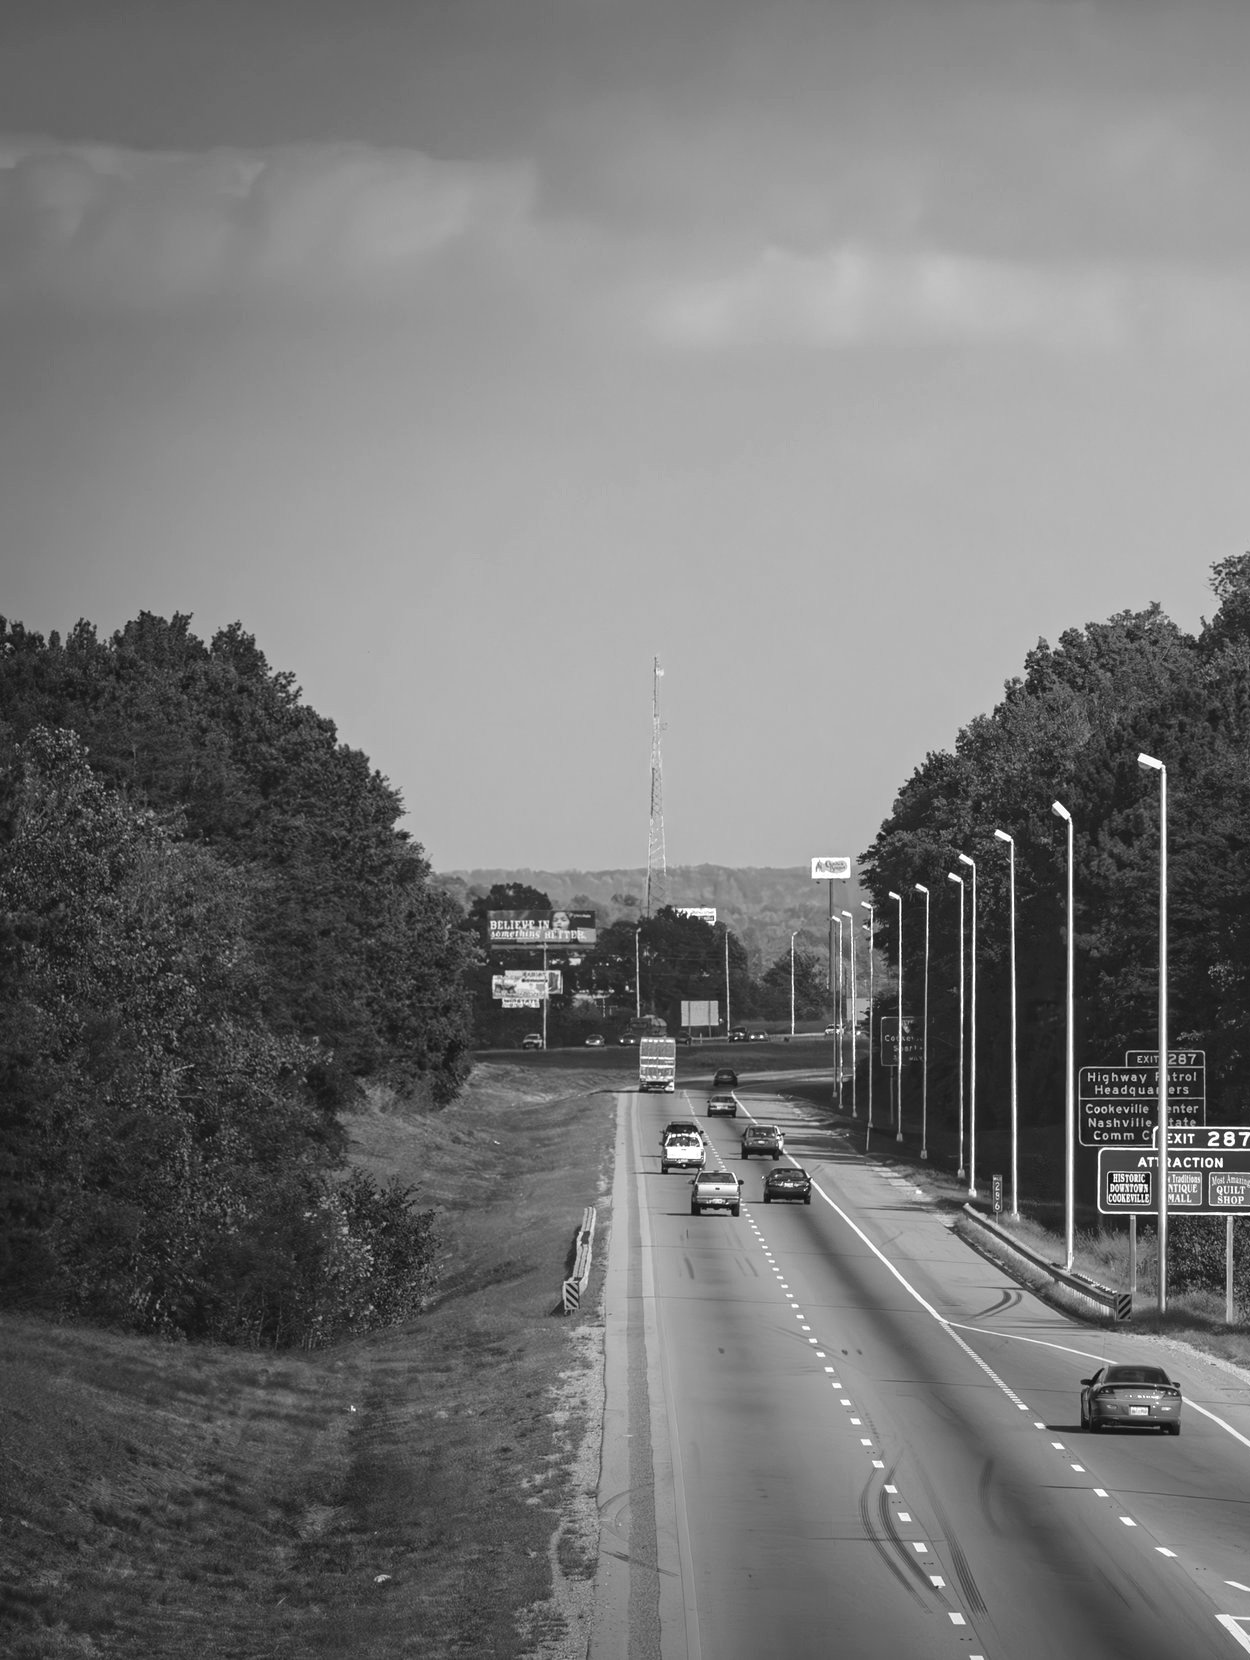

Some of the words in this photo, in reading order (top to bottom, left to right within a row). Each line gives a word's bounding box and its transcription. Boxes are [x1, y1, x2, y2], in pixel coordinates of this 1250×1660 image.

[490, 920, 535, 930] BELIEVE
[538, 920, 550, 930] IN
[1136, 1055, 1159, 1064] EXIT
[1168, 1053, 1197, 1065] 287
[1087, 1072, 1147, 1085] Highway
[1085, 1103, 1150, 1114] Cookeville
[1088, 1117, 1152, 1128] Nashville
[1168, 1117, 1197, 1127] tate
[1093, 1130, 1135, 1141] Comm
[1207, 1131, 1250, 1147] 287
[1112, 1173, 1146, 1183] HISTORIC
[1171, 1173, 1201, 1184] Traditions
[1211, 1175, 1226, 1187] Most
[1226, 1174, 1250, 1189] Amazing
[1109, 1183, 1149, 1193] DOWNTOWN
[1167, 1183, 1198, 1195] NTIQUE
[1216, 1185, 1246, 1196] QUILT
[1108, 1193, 1150, 1203] COOKEVILLE
[1167, 1193, 1192, 1203] MALL
[1217, 1195, 1245, 1205] SHOP
